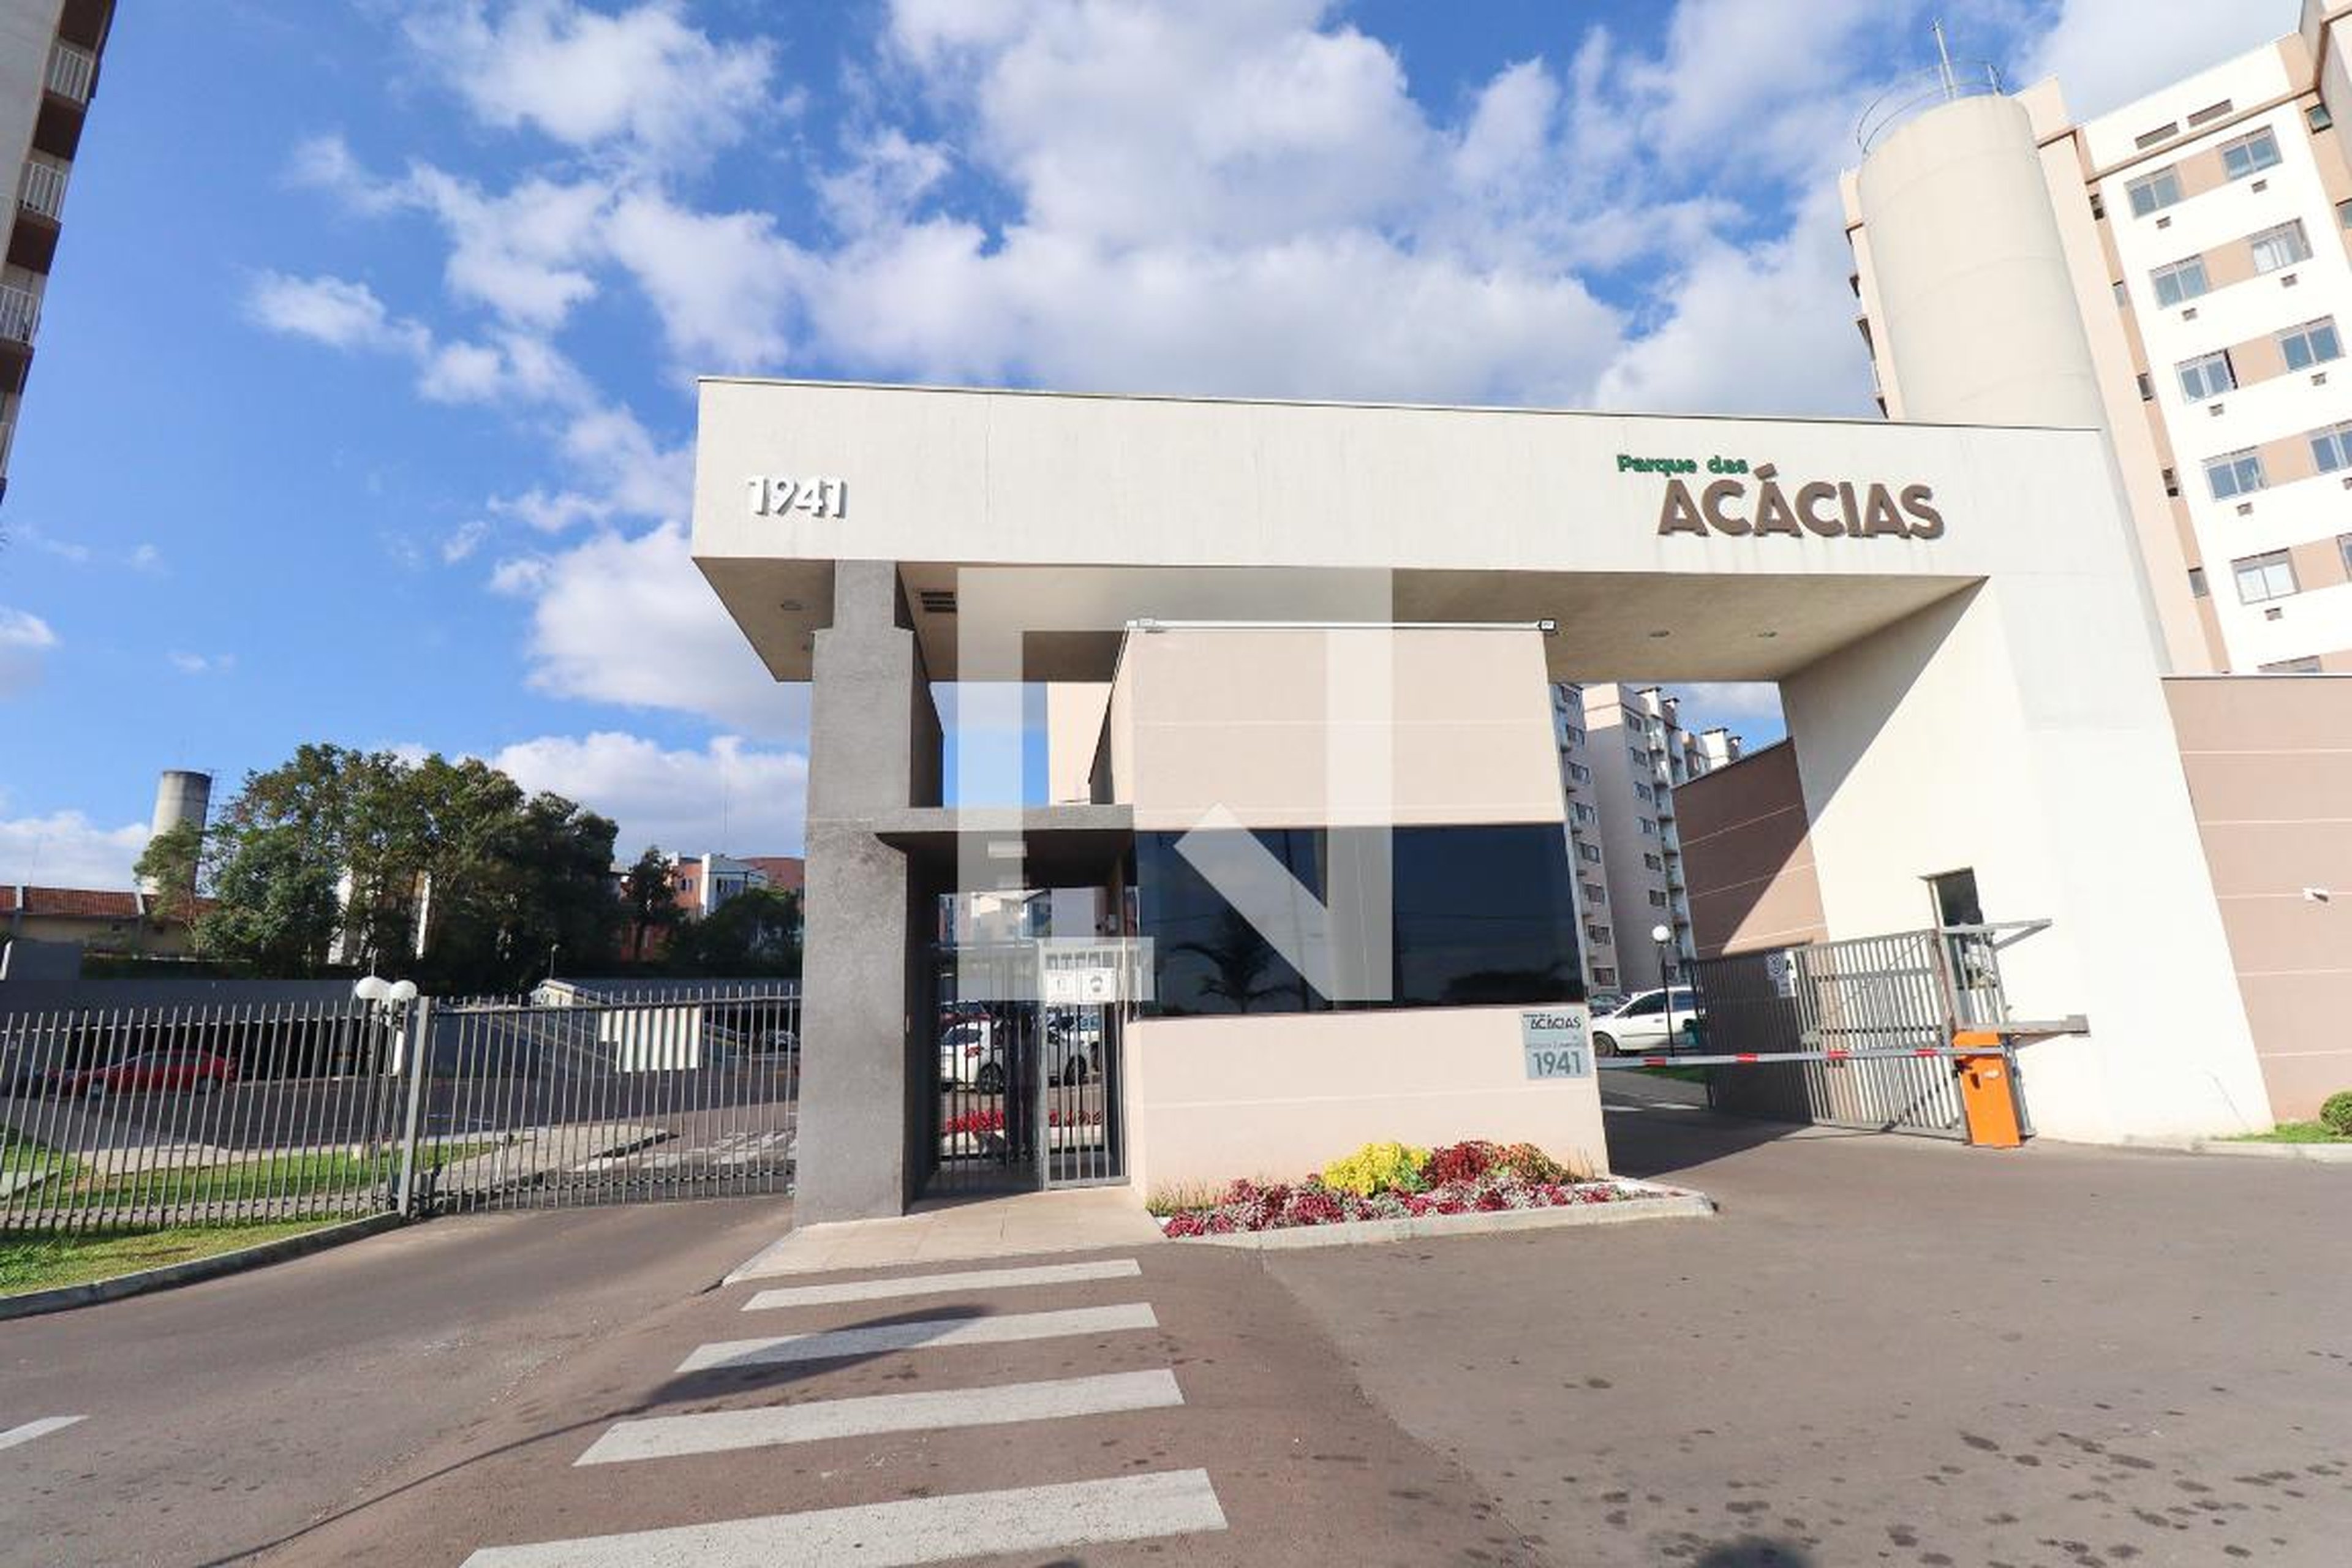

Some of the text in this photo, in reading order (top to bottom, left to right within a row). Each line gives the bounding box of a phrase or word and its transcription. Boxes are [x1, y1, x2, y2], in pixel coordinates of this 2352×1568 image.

[1617, 455, 1749, 477] Parque das
[746, 474, 848, 519] 1941
[1657, 463, 1944, 539] ACÁCIAS
[1532, 1051, 1581, 1076] 1941
